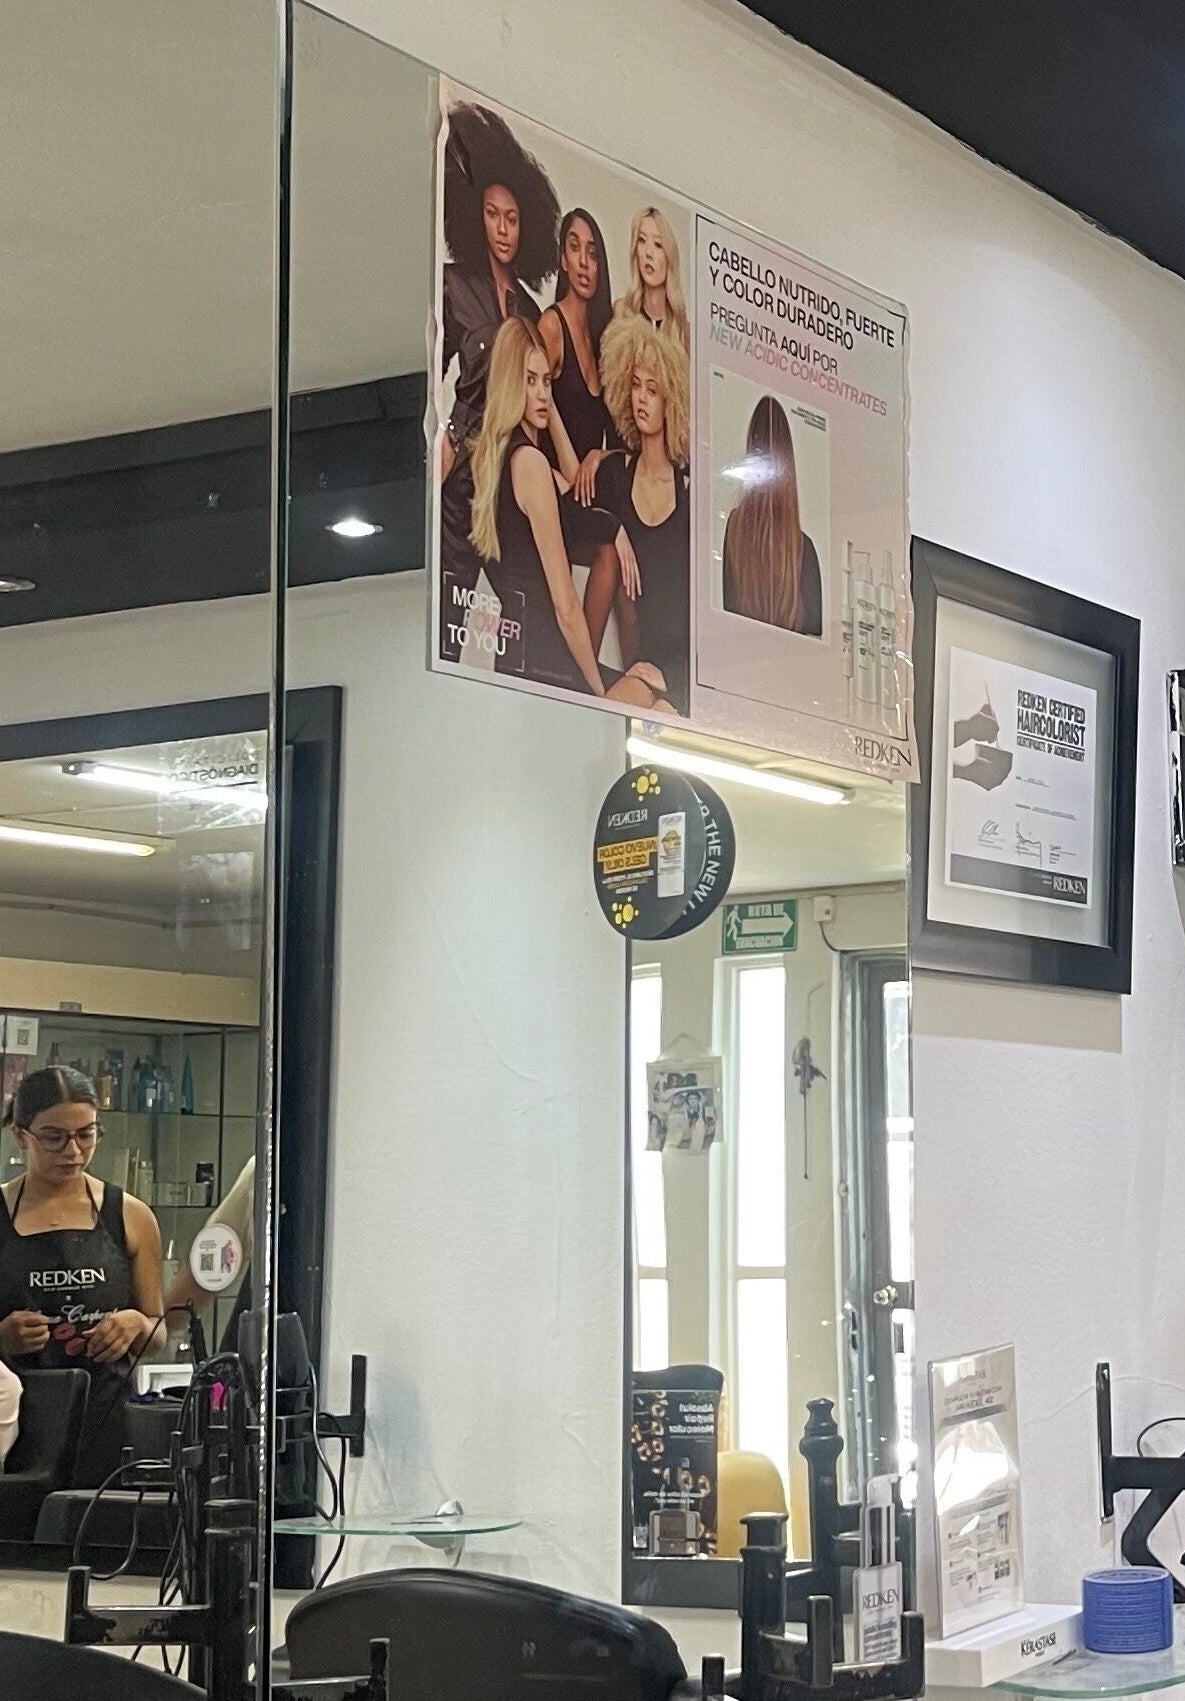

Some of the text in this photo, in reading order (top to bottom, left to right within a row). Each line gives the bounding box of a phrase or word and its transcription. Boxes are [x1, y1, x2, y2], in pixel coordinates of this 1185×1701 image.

[709, 242, 895, 349] CABELLO NUTRIDO, FUERTE
[709, 265, 854, 351] Y COLOR DURADERO
[710, 302, 839, 376] PREGUNTA AQUÍ POR
[709, 323, 888, 417] NEW ACIDIC CONCENTRATES
[452, 585, 500, 616] MORE
[447, 623, 507, 656] TO YOU
[1017, 689, 1085, 725] REDKEN CERTIFIED
[1017, 707, 1086, 747] HAIRCOLORIST
[855, 735, 912, 768] REDKEN
[704, 818, 721, 857] THE
[693, 859, 720, 903] NEW
[1053, 875, 1086, 896] REDKEN
[30, 1267, 106, 1287] REDKEN
[863, 1588, 900, 1609] REDKEN
